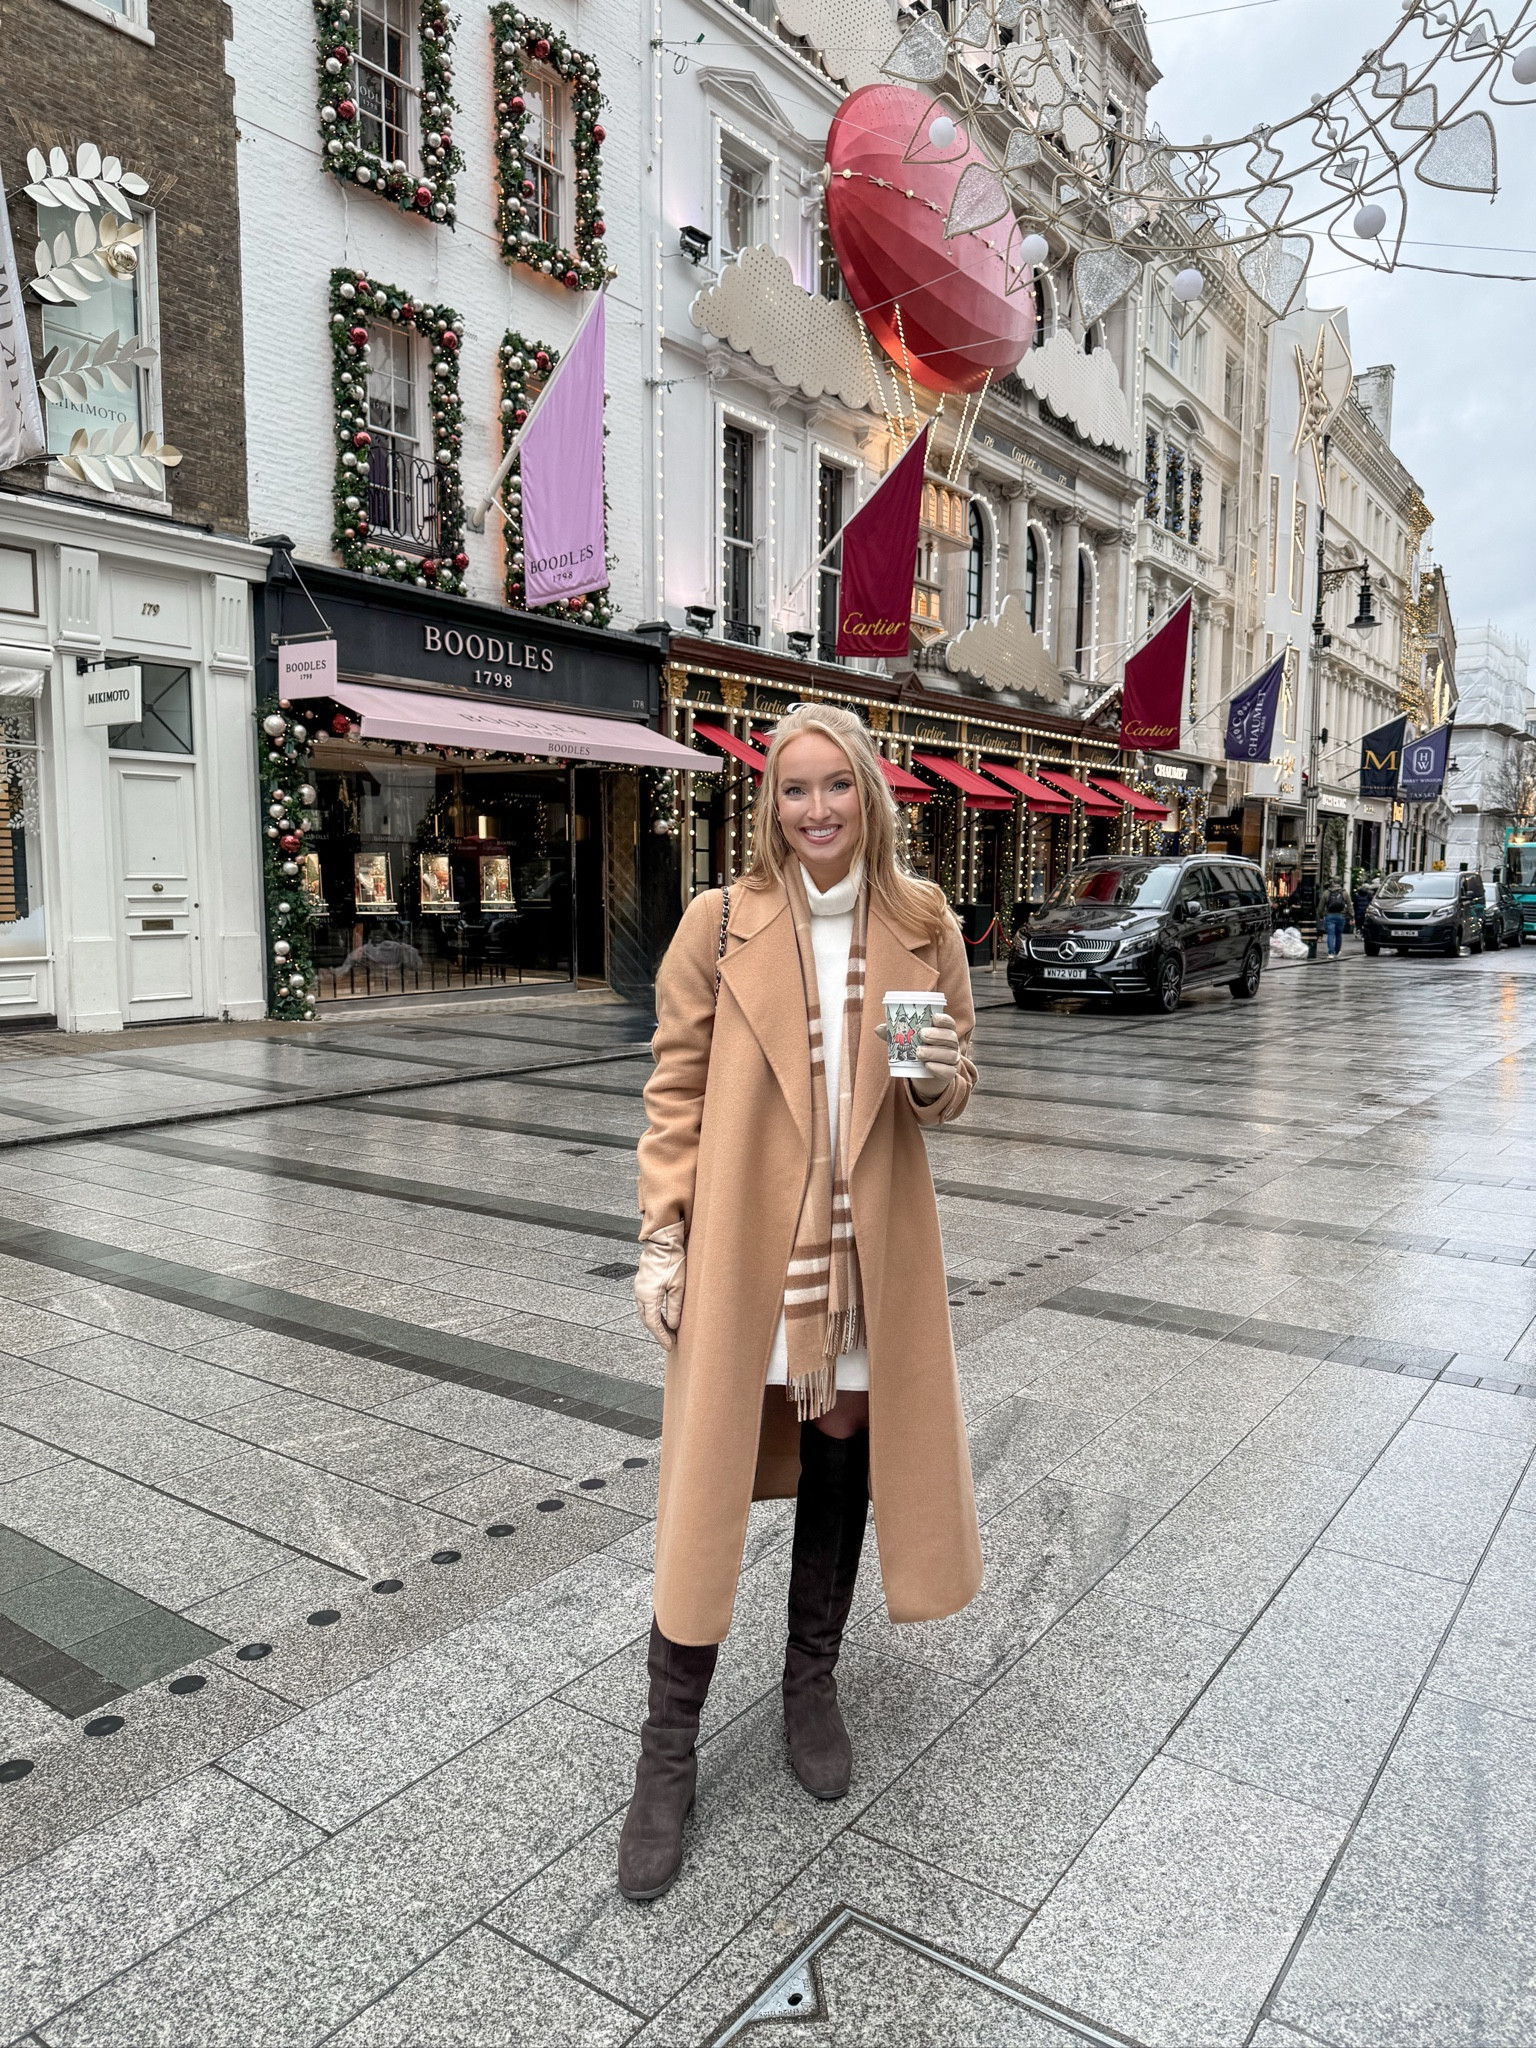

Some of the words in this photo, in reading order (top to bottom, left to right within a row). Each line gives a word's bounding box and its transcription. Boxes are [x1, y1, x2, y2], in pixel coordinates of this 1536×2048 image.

[52, 398, 127, 424] IKIMOTO
[1012, 446, 1036, 470] Cartier
[530, 544, 594, 575] BOODLES
[552, 571, 573, 583] 1798
[142, 602, 160, 616] 179
[843, 612, 906, 636] Cartier
[424, 625, 554, 672] BOODLES
[285, 660, 327, 673] BOODLES
[474, 669, 513, 689] 1798
[88, 689, 130, 705] MIKIMOTO
[632, 699, 645, 709] 178
[696, 690, 711, 702] 177
[459, 713, 587, 735] BOODLES
[915, 721, 946, 740] Cartier
[1124, 719, 1178, 737] Cartier
[1248, 690, 1266, 757] CHAUMET
[981, 732, 1008, 749] Cartier
[548, 743, 590, 756] BOODLES
[1038, 742, 1062, 758] Cartier
[1420, 752, 1428, 761] H
[1362, 750, 1399, 770] M
[1417, 761, 1430, 770] W
[1154, 763, 1188, 780] CHAUMET
[1047, 968, 1066, 978] WN72
[1068, 968, 1084, 978] VOT
